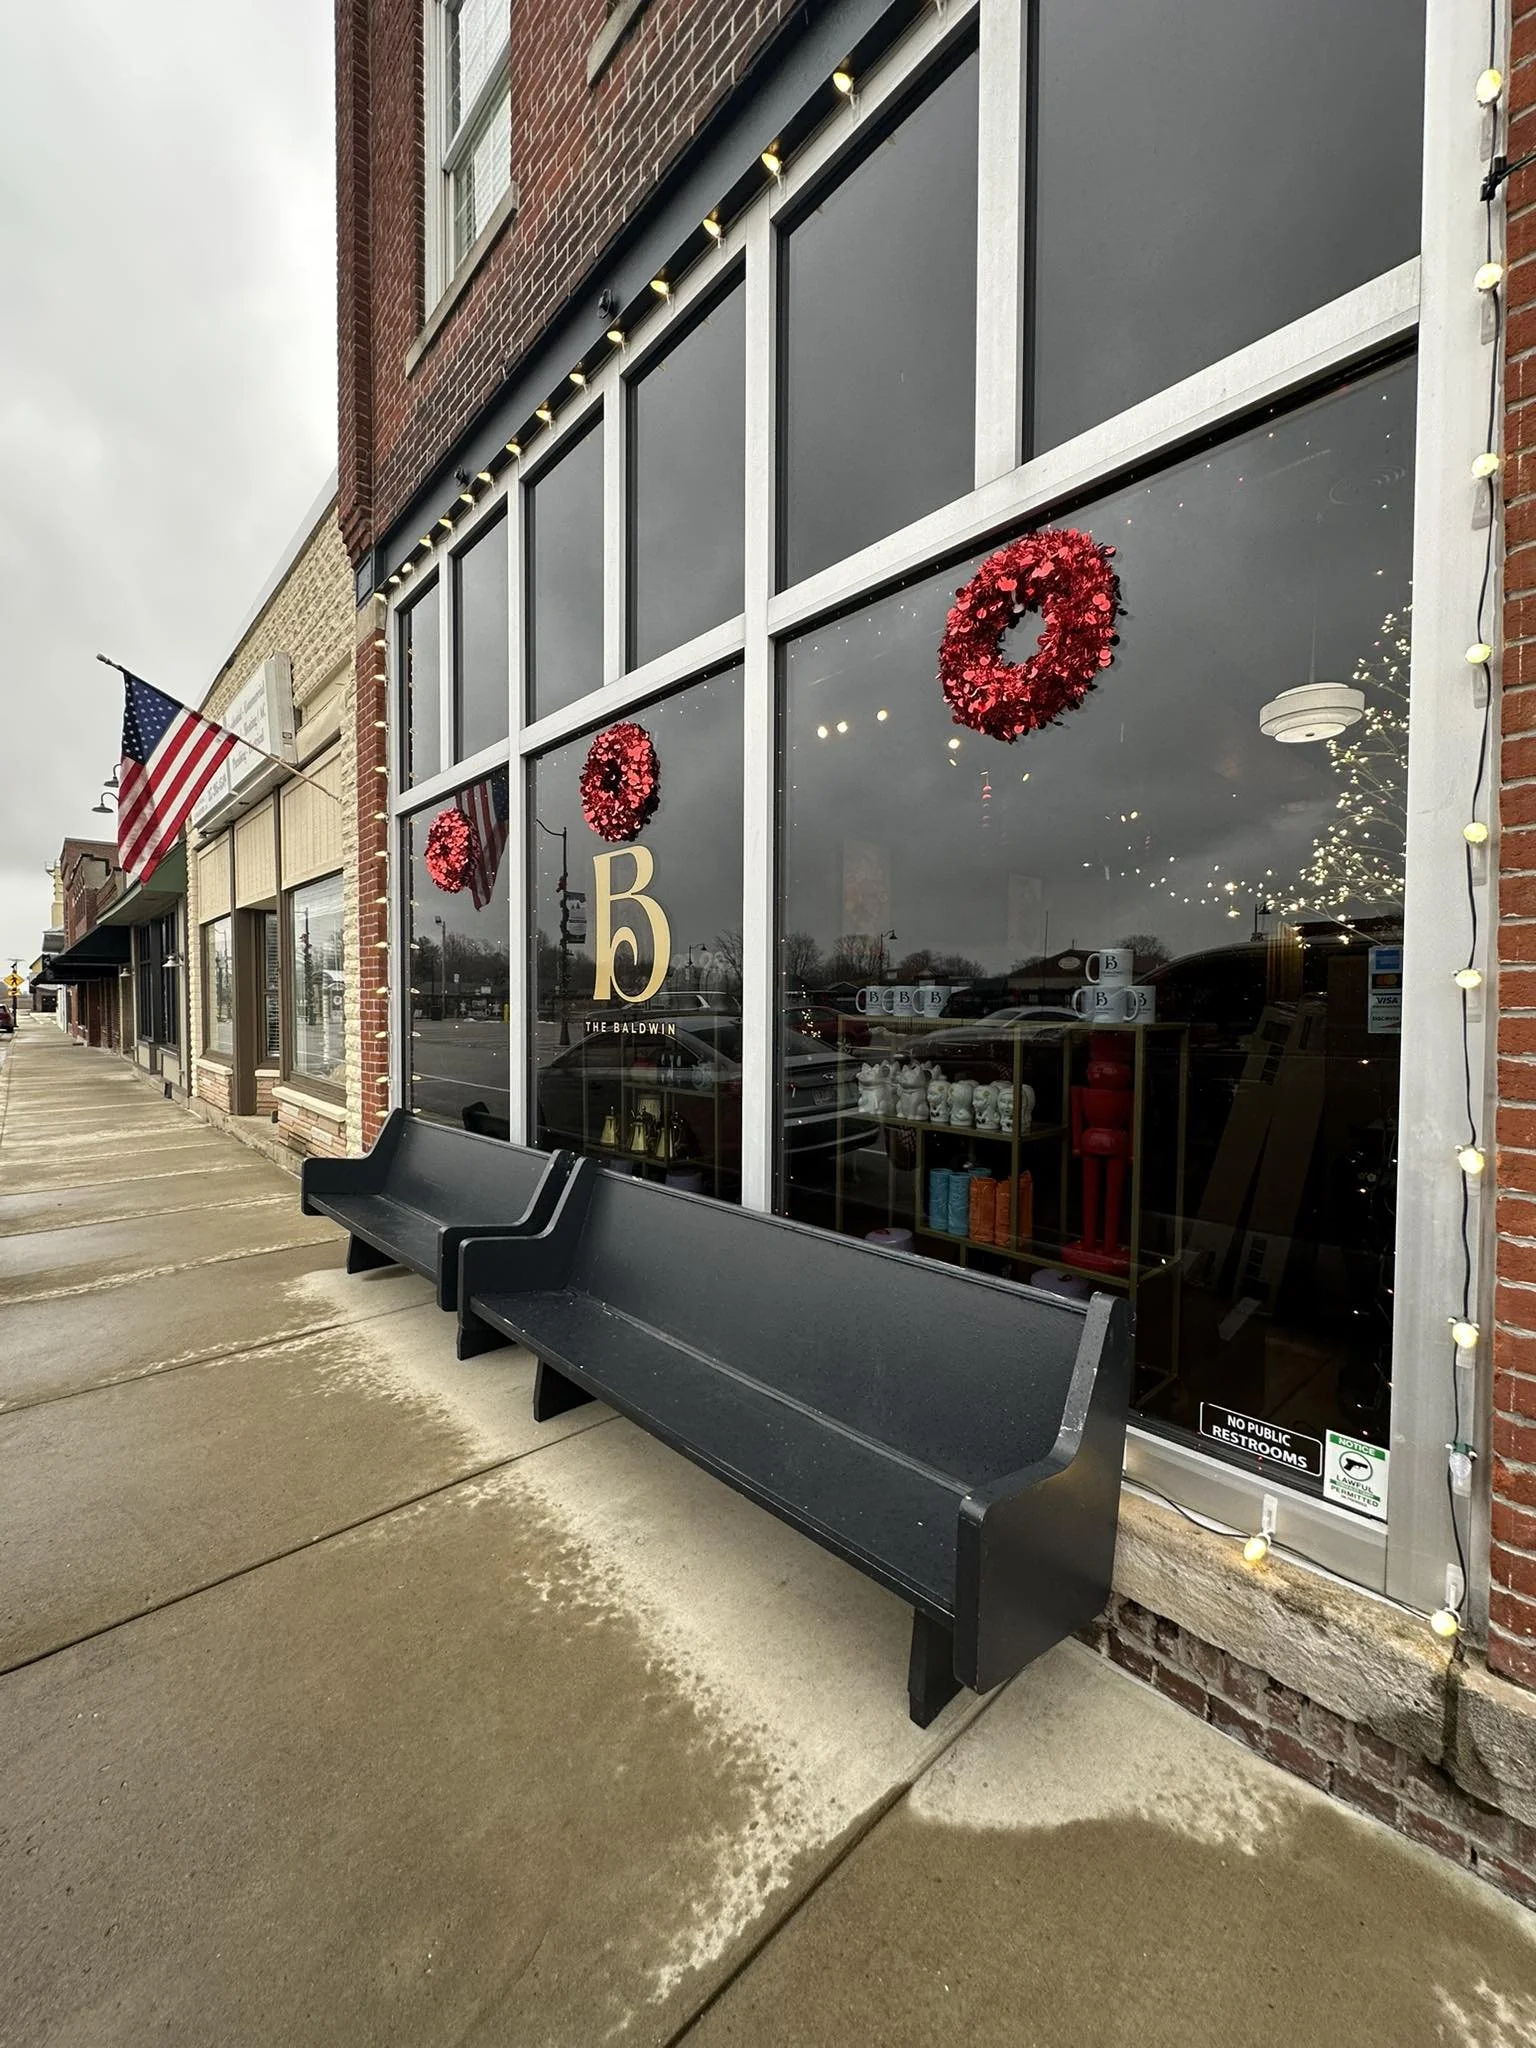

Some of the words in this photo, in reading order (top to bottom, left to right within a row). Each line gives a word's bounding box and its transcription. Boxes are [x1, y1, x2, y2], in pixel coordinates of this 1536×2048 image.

[593, 845, 671, 1003] B
[585, 1021, 607, 1033] THE
[613, 1022, 676, 1035] BALDWIN
[1227, 1414, 1246, 1430] NO
[1247, 1421, 1292, 1447] PUBLIC
[1212, 1425, 1308, 1468] RESTROOMS
[1338, 1438, 1376, 1457] NOTICE
[1336, 1474, 1373, 1494] LAWFUL
[1330, 1485, 1379, 1507] PERMITTED
